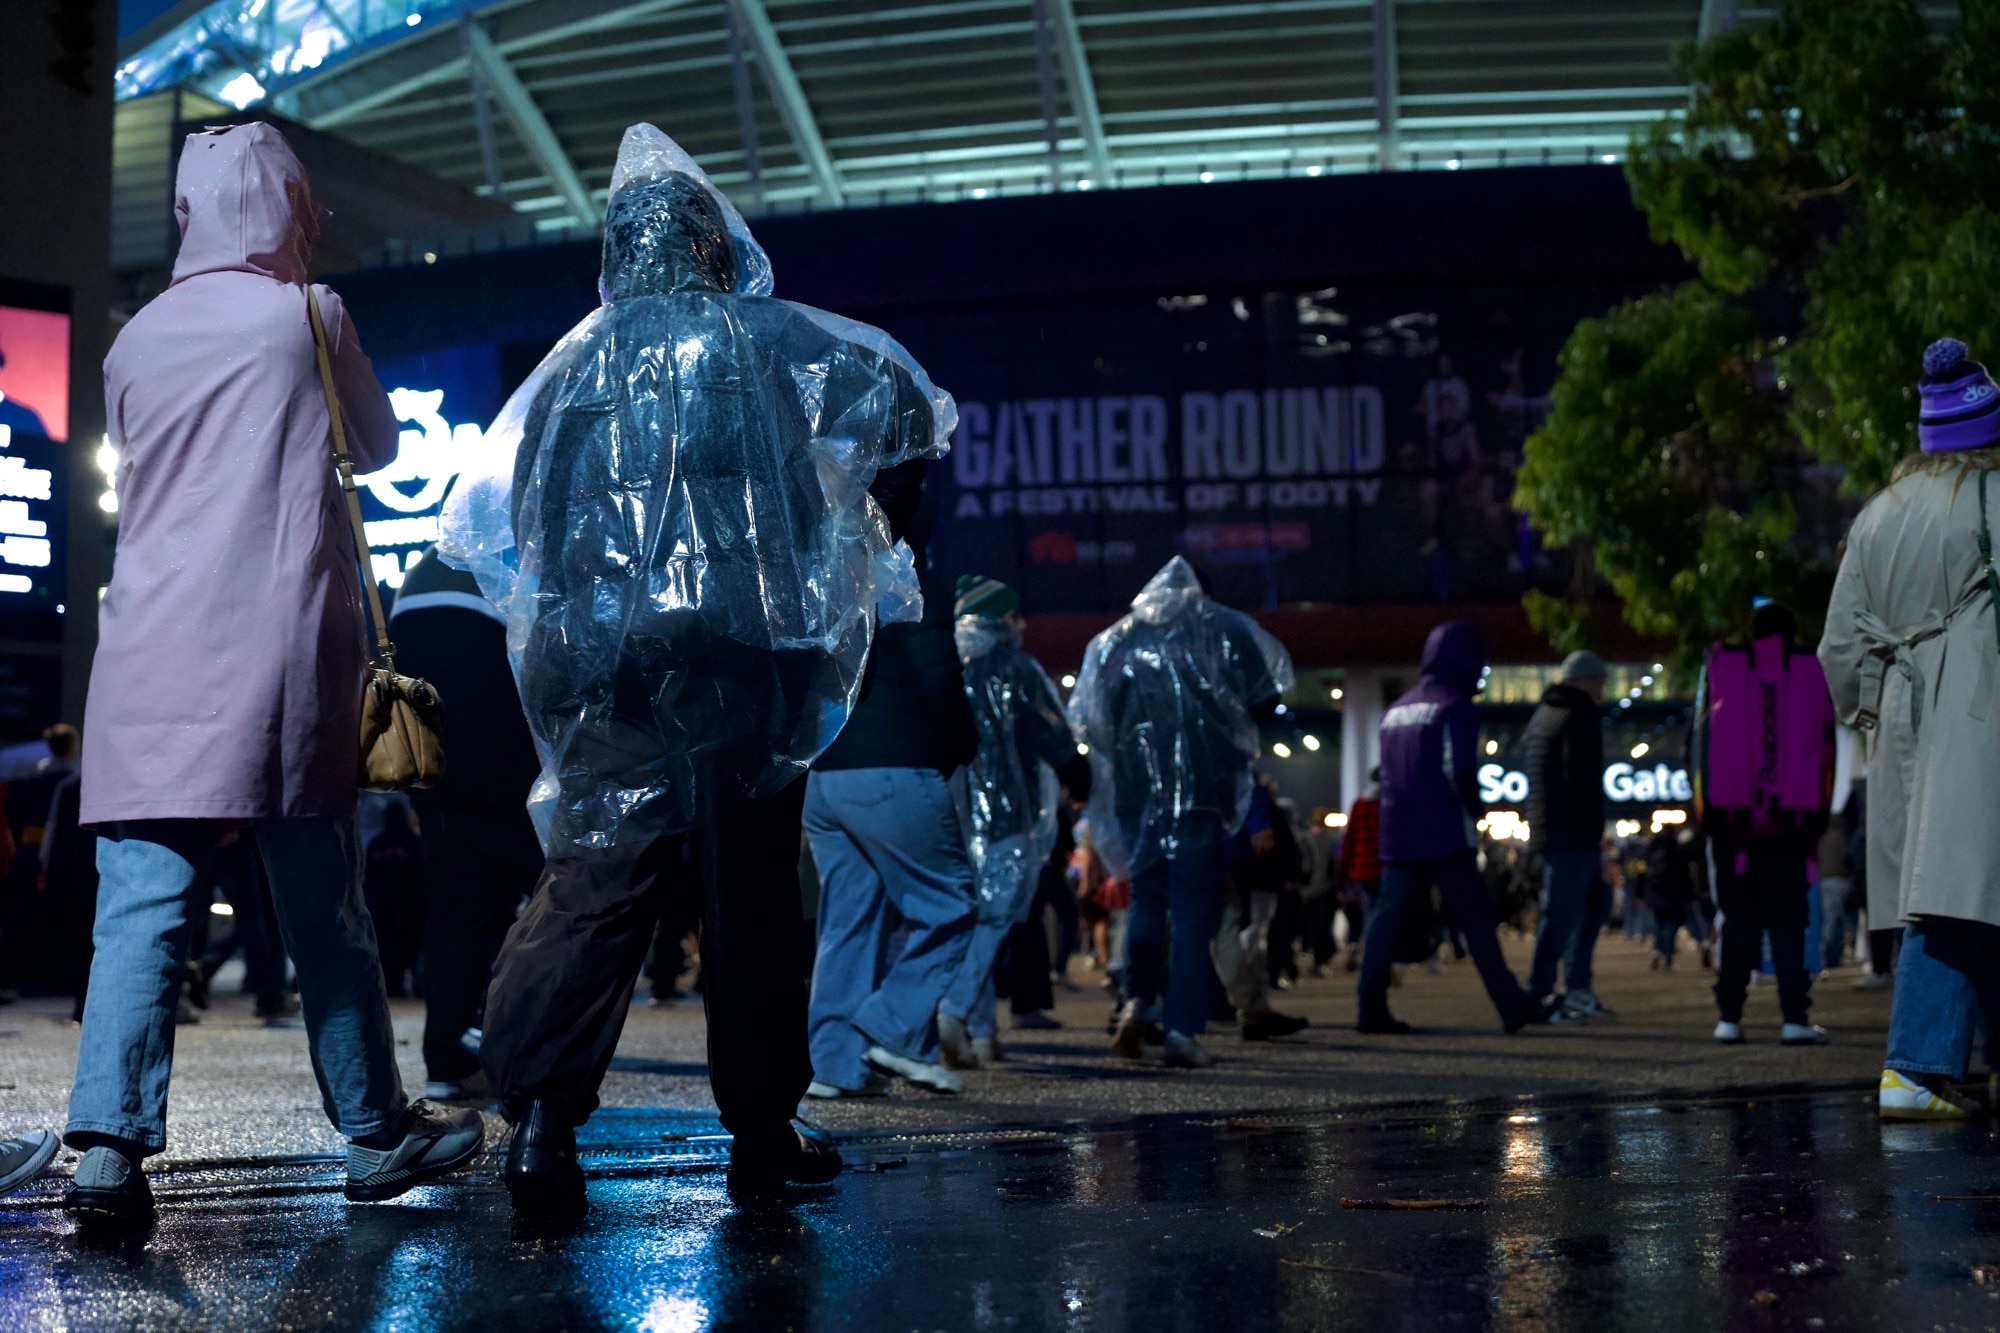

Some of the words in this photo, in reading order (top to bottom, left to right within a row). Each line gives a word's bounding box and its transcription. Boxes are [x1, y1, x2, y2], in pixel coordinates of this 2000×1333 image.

[954, 395, 1169, 487] GATHER
[1181, 385, 1385, 478] ROUND
[956, 493, 983, 517] A
[990, 486, 1175, 516] FESTIVAL
[1184, 483, 1239, 510] OF
[1247, 477, 1382, 510] FOOTY
